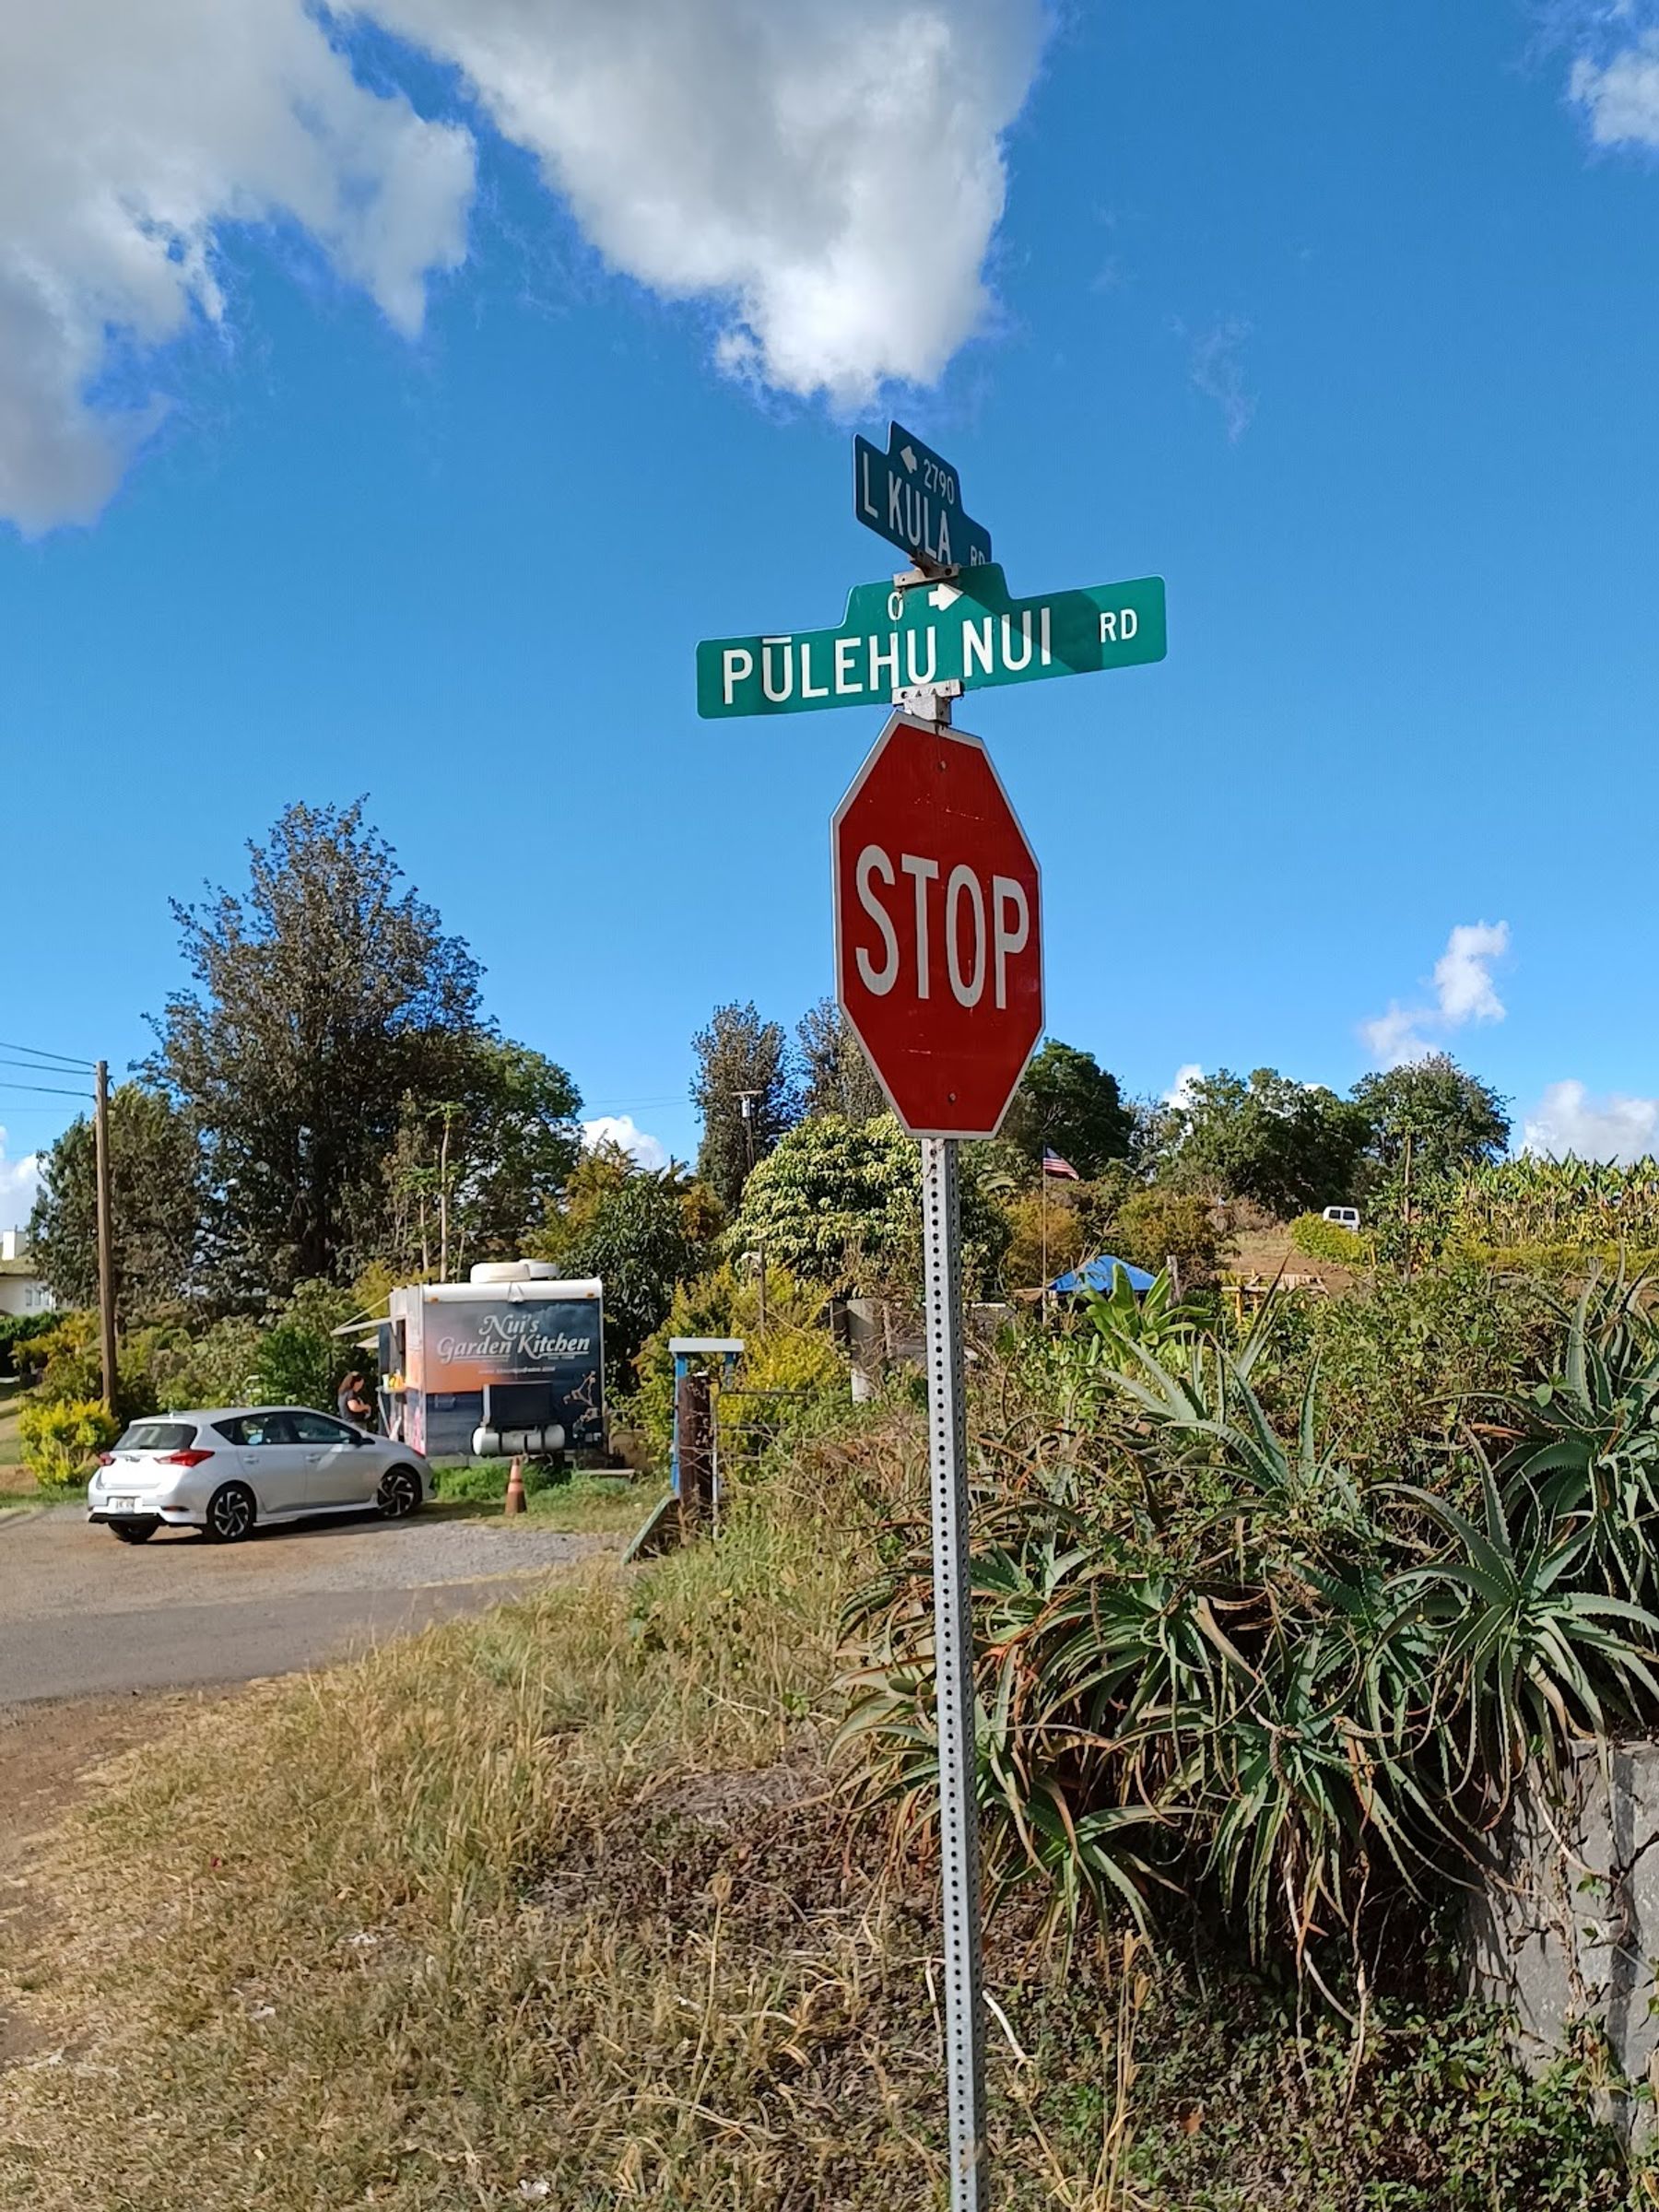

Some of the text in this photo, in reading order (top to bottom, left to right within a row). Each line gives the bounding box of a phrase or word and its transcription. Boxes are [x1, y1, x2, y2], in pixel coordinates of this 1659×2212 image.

[863, 451, 878, 519] L
[888, 470, 952, 565] KULA
[924, 459, 955, 505] 2790
[724, 606, 1138, 705] PŪLEHU NUI RD
[855, 844, 1030, 1010] STOP
[437, 1332, 591, 1364] Garden Kitchen
[478, 1313, 540, 1340] Nui's
